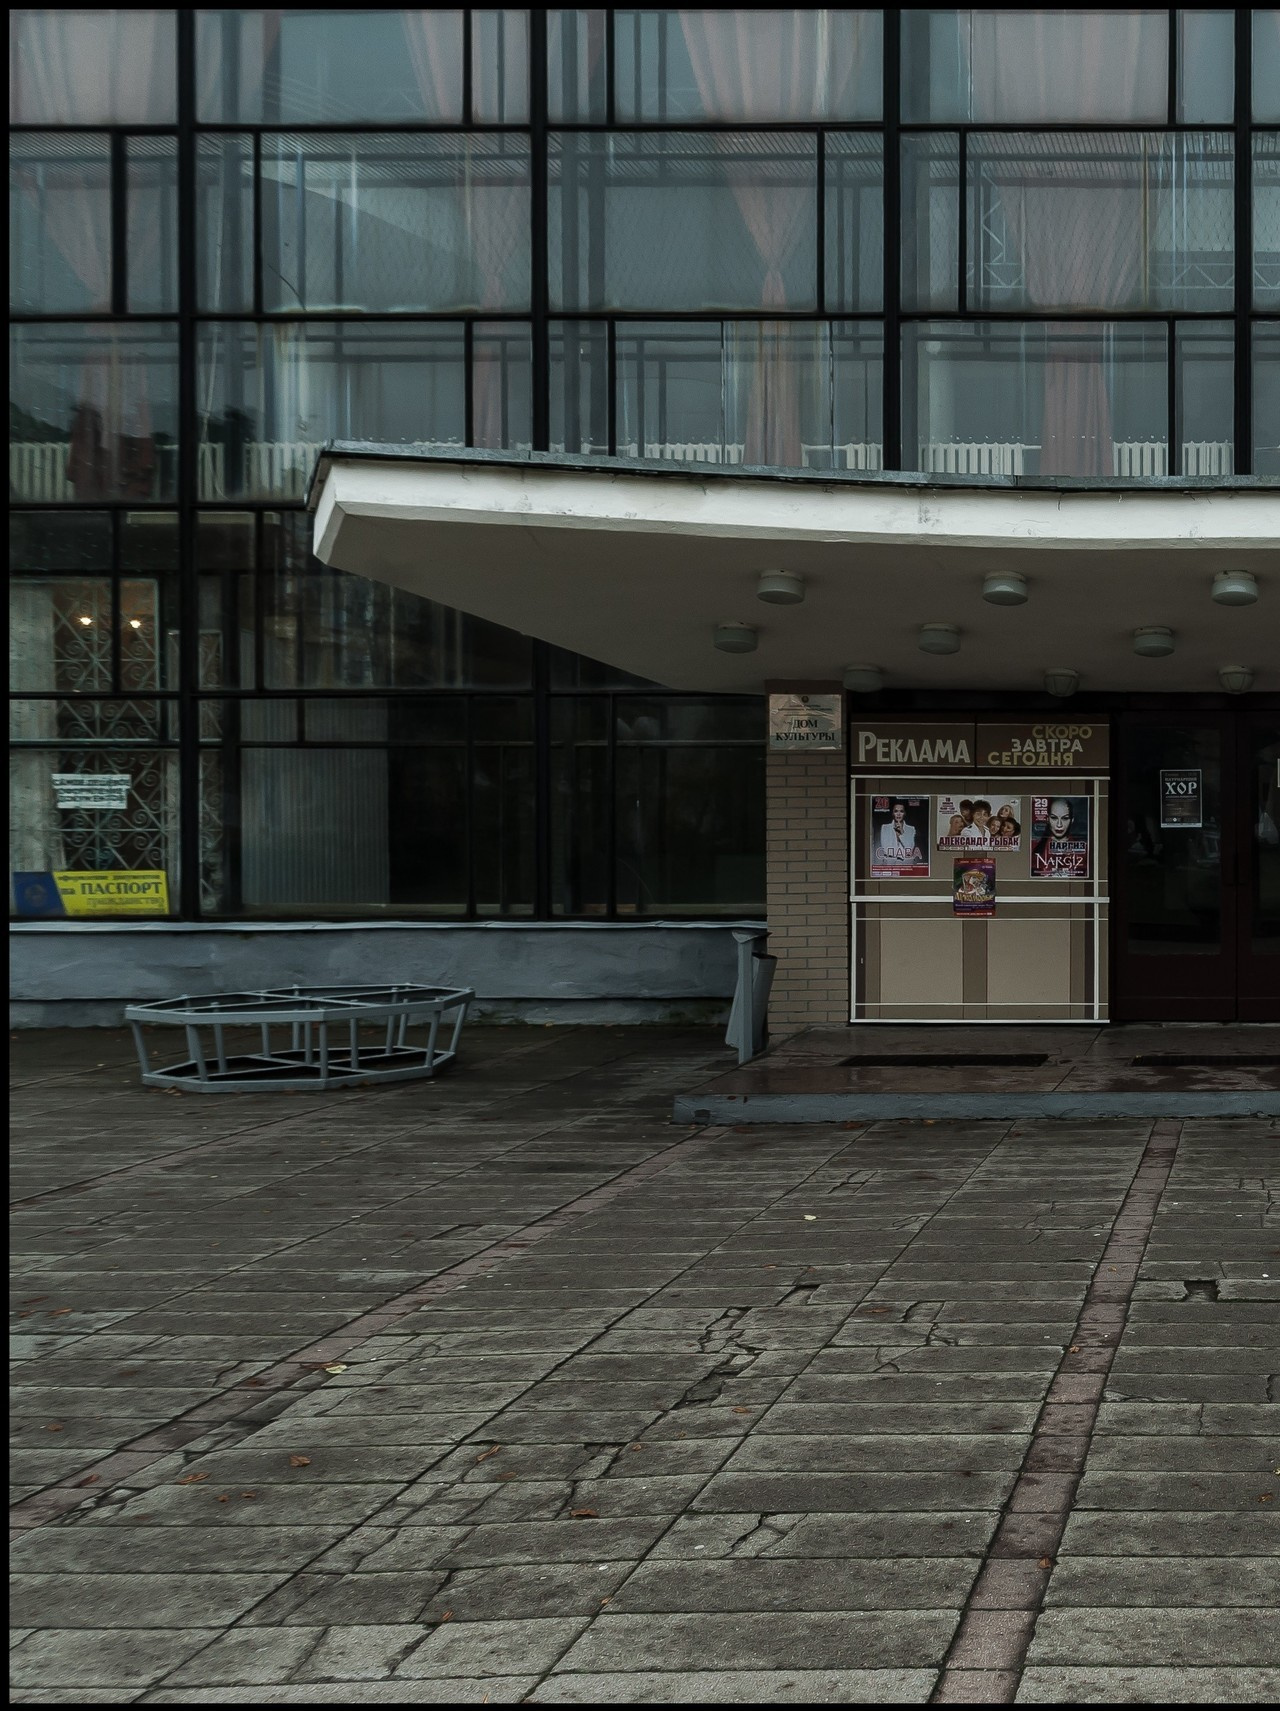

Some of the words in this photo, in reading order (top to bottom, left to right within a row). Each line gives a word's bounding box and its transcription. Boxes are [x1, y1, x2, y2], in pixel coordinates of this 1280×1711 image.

[792, 719, 818, 729] ДОМ
[776, 732, 835, 741] КУЛЬТУРЫ
[1031, 725, 1093, 739] СКОРО
[857, 731, 971, 763] РЕКЛАМА
[1011, 738, 1084, 752] ЗАВТРА
[987, 751, 1074, 766] СЕГОДНЯ
[1165, 781, 1198, 795] ХОР
[1034, 798, 1049, 808] 29
[939, 836, 988, 847] АЛЕКСАНДР
[989, 836, 1019, 846] РЫБАК
[1049, 841, 1086, 850] НАРГИЗ
[876, 846, 923, 860] СЛАВА
[80, 881, 163, 895] ПАСПОРТ
